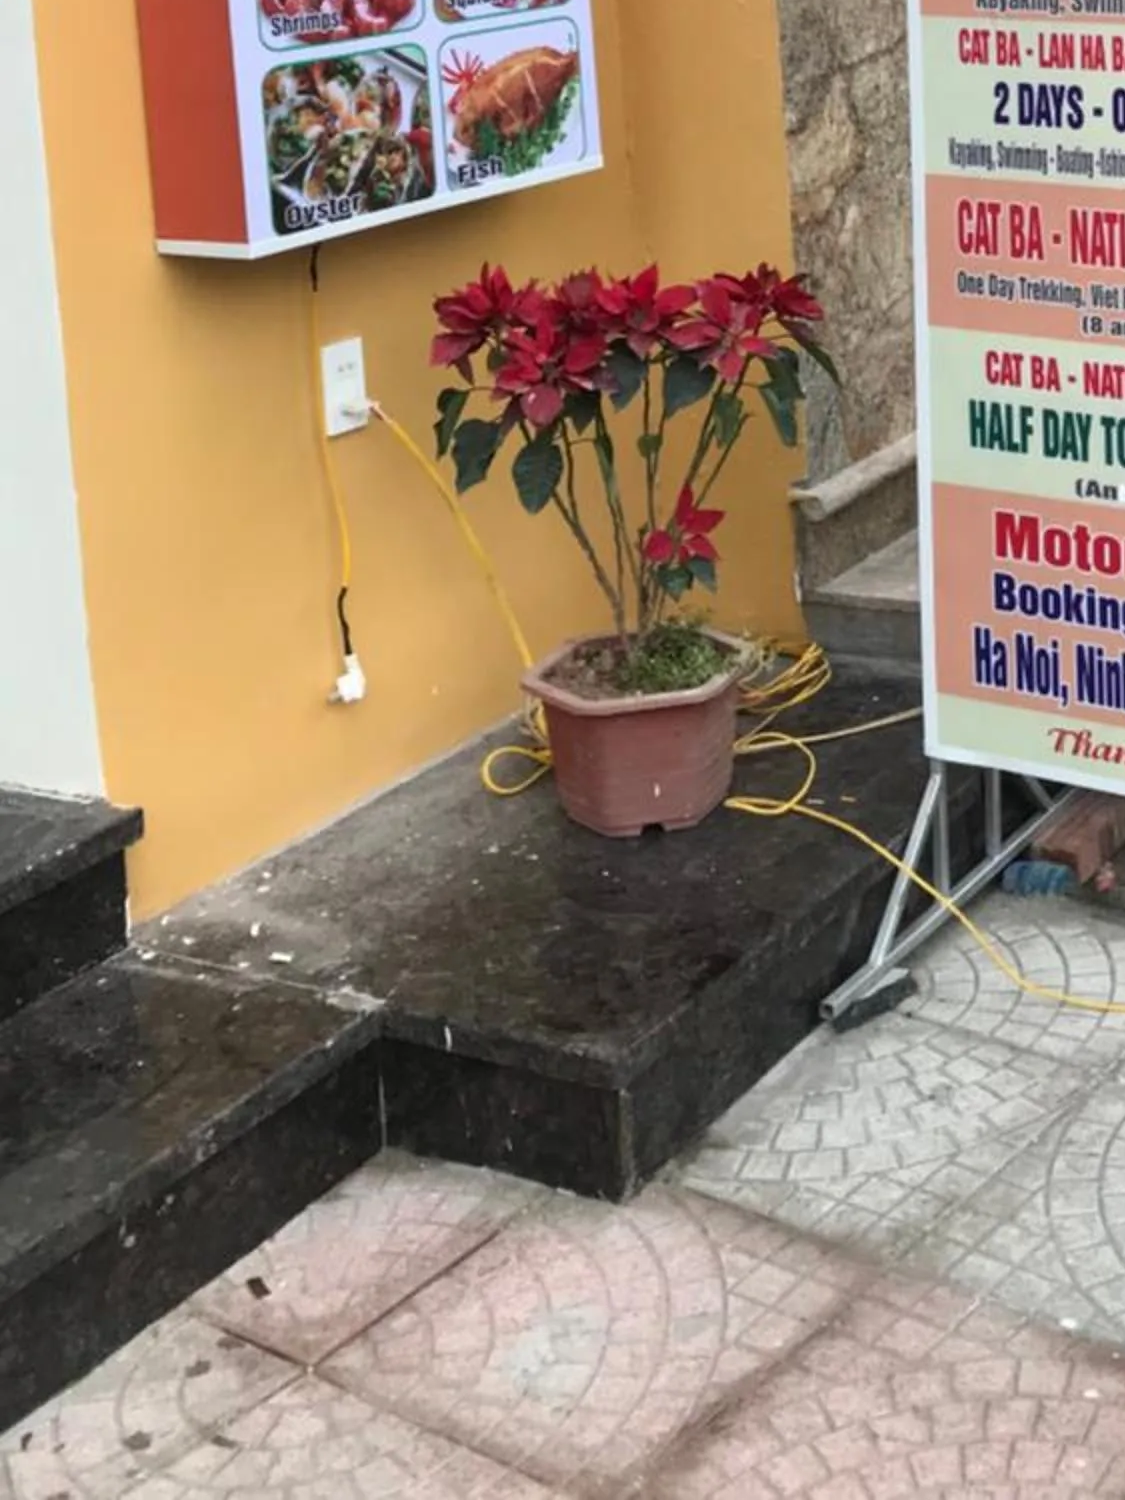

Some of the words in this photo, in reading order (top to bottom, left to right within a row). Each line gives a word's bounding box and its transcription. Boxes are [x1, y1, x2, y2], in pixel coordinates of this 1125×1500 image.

[271, 12, 340, 36] Shrimps
[994, 81, 1010, 125] 2
[1017, 82, 1084, 130] DAYS
[458, 157, 503, 185] Fish
[284, 196, 362, 229] Oyster
[957, 200, 1000, 257] CAT
[1009, 203, 1044, 261] BA
[957, 270, 984, 296] One
[988, 273, 1015, 300] Day
[1019, 277, 1087, 308] Trekking,
[1090, 283, 1120, 310] Viet
[985, 350, 1023, 385] CAT
[1031, 355, 1061, 392] BA
[968, 400, 1035, 454] HALF
[1042, 410, 1093, 463] DAY
[974, 626, 1008, 688] Ha
[1015, 633, 1070, 708] Noi,
